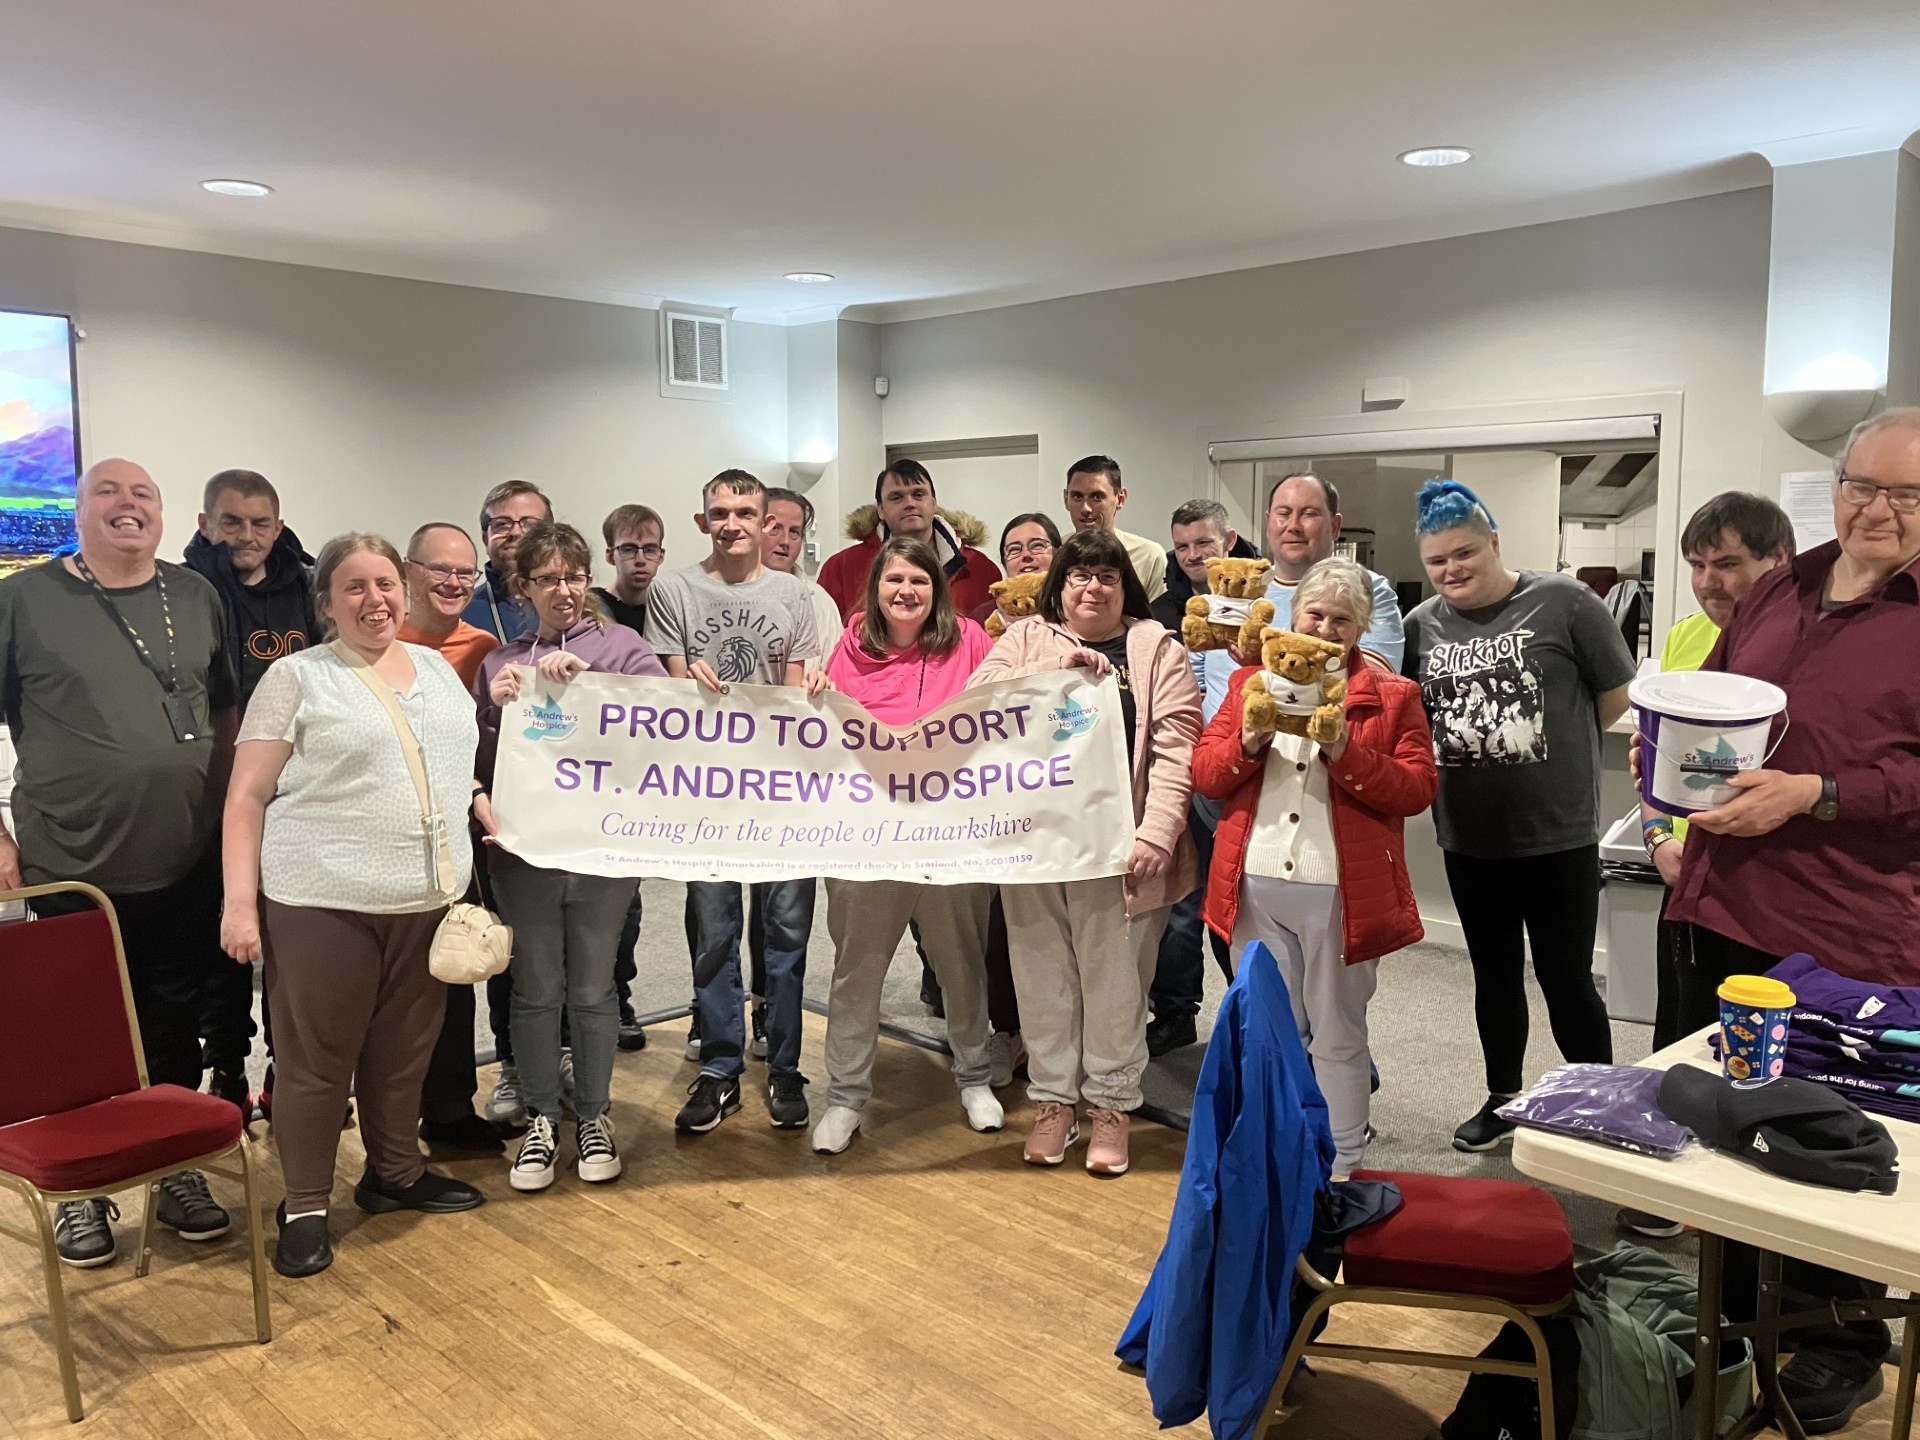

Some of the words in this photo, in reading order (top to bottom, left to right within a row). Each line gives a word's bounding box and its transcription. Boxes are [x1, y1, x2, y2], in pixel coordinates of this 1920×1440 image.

[688, 609, 784, 664] ROSSHATCH
[536, 710, 579, 722] Andrew's
[1060, 705, 1099, 720] Andrew's
[532, 720, 568, 730] Hospice
[600, 703, 756, 744] PROUD
[769, 714, 828, 749] TO
[841, 704, 1031, 751] SUPPORT
[1060, 717, 1089, 729] Hospice
[1703, 754, 1754, 767] Andrew's
[554, 757, 622, 794] ST.
[637, 763, 874, 803] ANDREW'S
[888, 754, 1074, 803] HOSPICE
[601, 812, 687, 844] Caring
[689, 817, 729, 844] for
[737, 819, 772, 842] the
[778, 820, 853, 847] people
[862, 820, 889, 847] of
[892, 812, 1032, 843] Lanarkshire
[605, 854, 615, 862] St
[618, 856, 669, 865] Andrew's
[672, 859, 713, 868] Hospice
[716, 860, 785, 869] (Lanarkshire)
[807, 861, 860, 871] registered
[863, 861, 899, 871] charity
[985, 854, 1033, 866] SC010159
[1829, 1075, 1843, 1084] the
